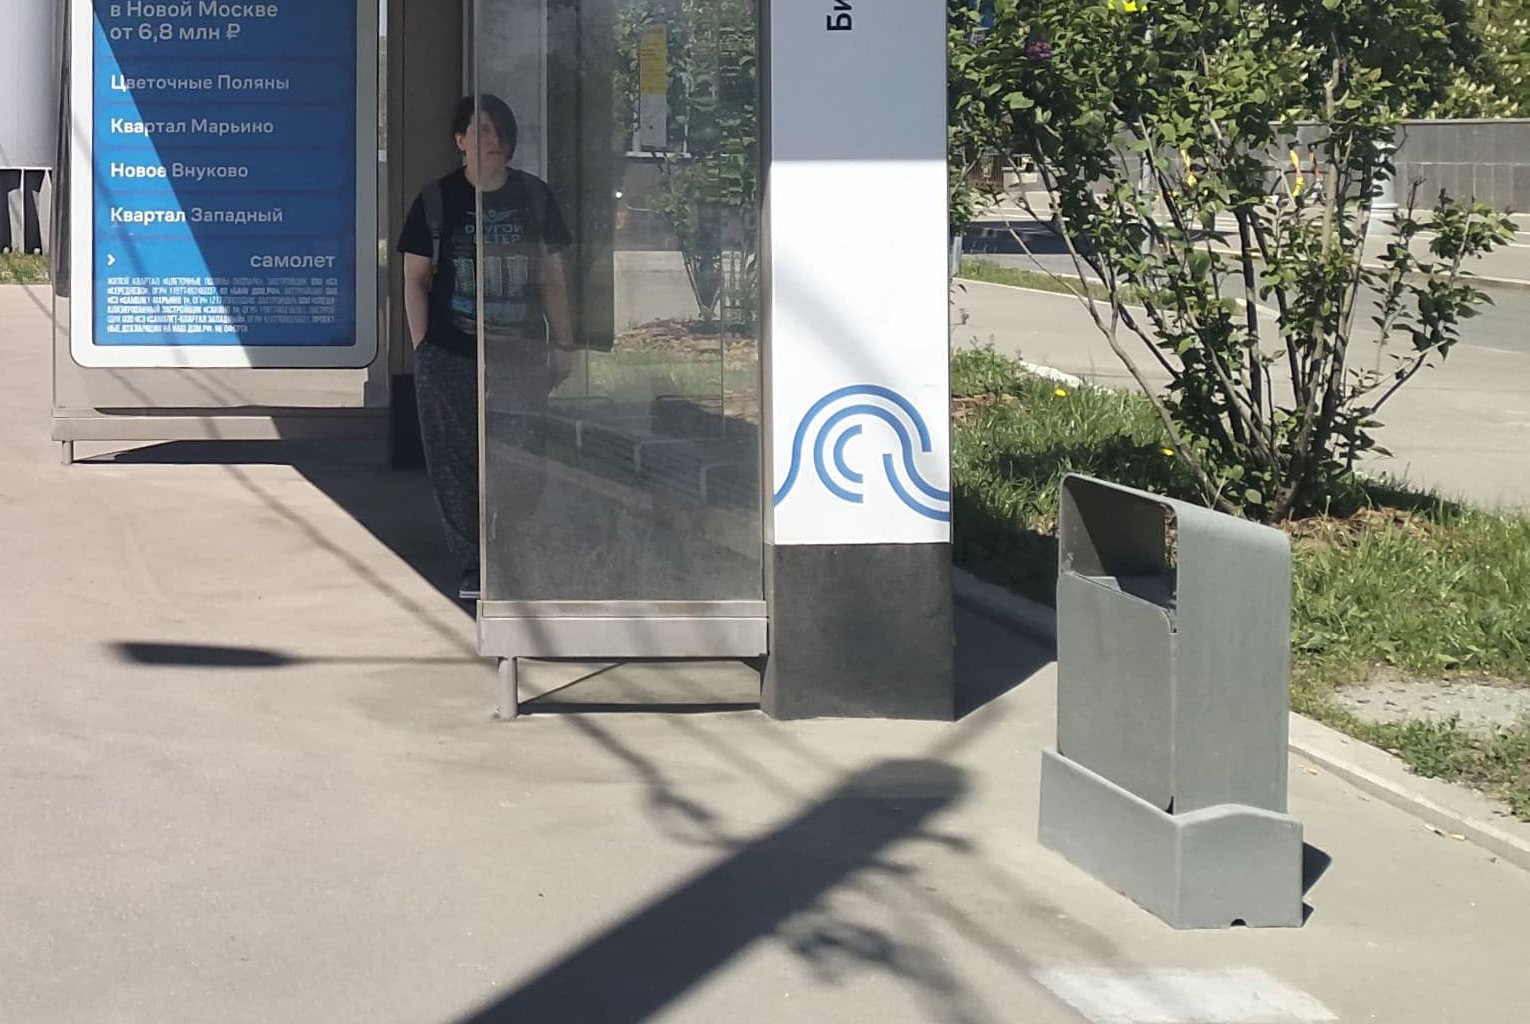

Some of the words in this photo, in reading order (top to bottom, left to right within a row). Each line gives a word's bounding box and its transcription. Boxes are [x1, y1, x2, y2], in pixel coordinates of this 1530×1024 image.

[111, 5, 120, 16] в
[199, 0, 278, 17] Москве
[110, 27, 133, 39] от
[139, 23, 172, 42] 6,8
[180, 28, 219, 40] млн
[112, 74, 212, 92] Цветочные
[218, 75, 289, 89] Поляны
[111, 118, 185, 136] Квартал
[192, 119, 273, 135] Марьино
[111, 163, 166, 177] Новое
[173, 163, 248, 179] Внуково
[111, 207, 185, 224] Квартал
[191, 208, 282, 224] Западный
[251, 256, 335, 268] самолет
